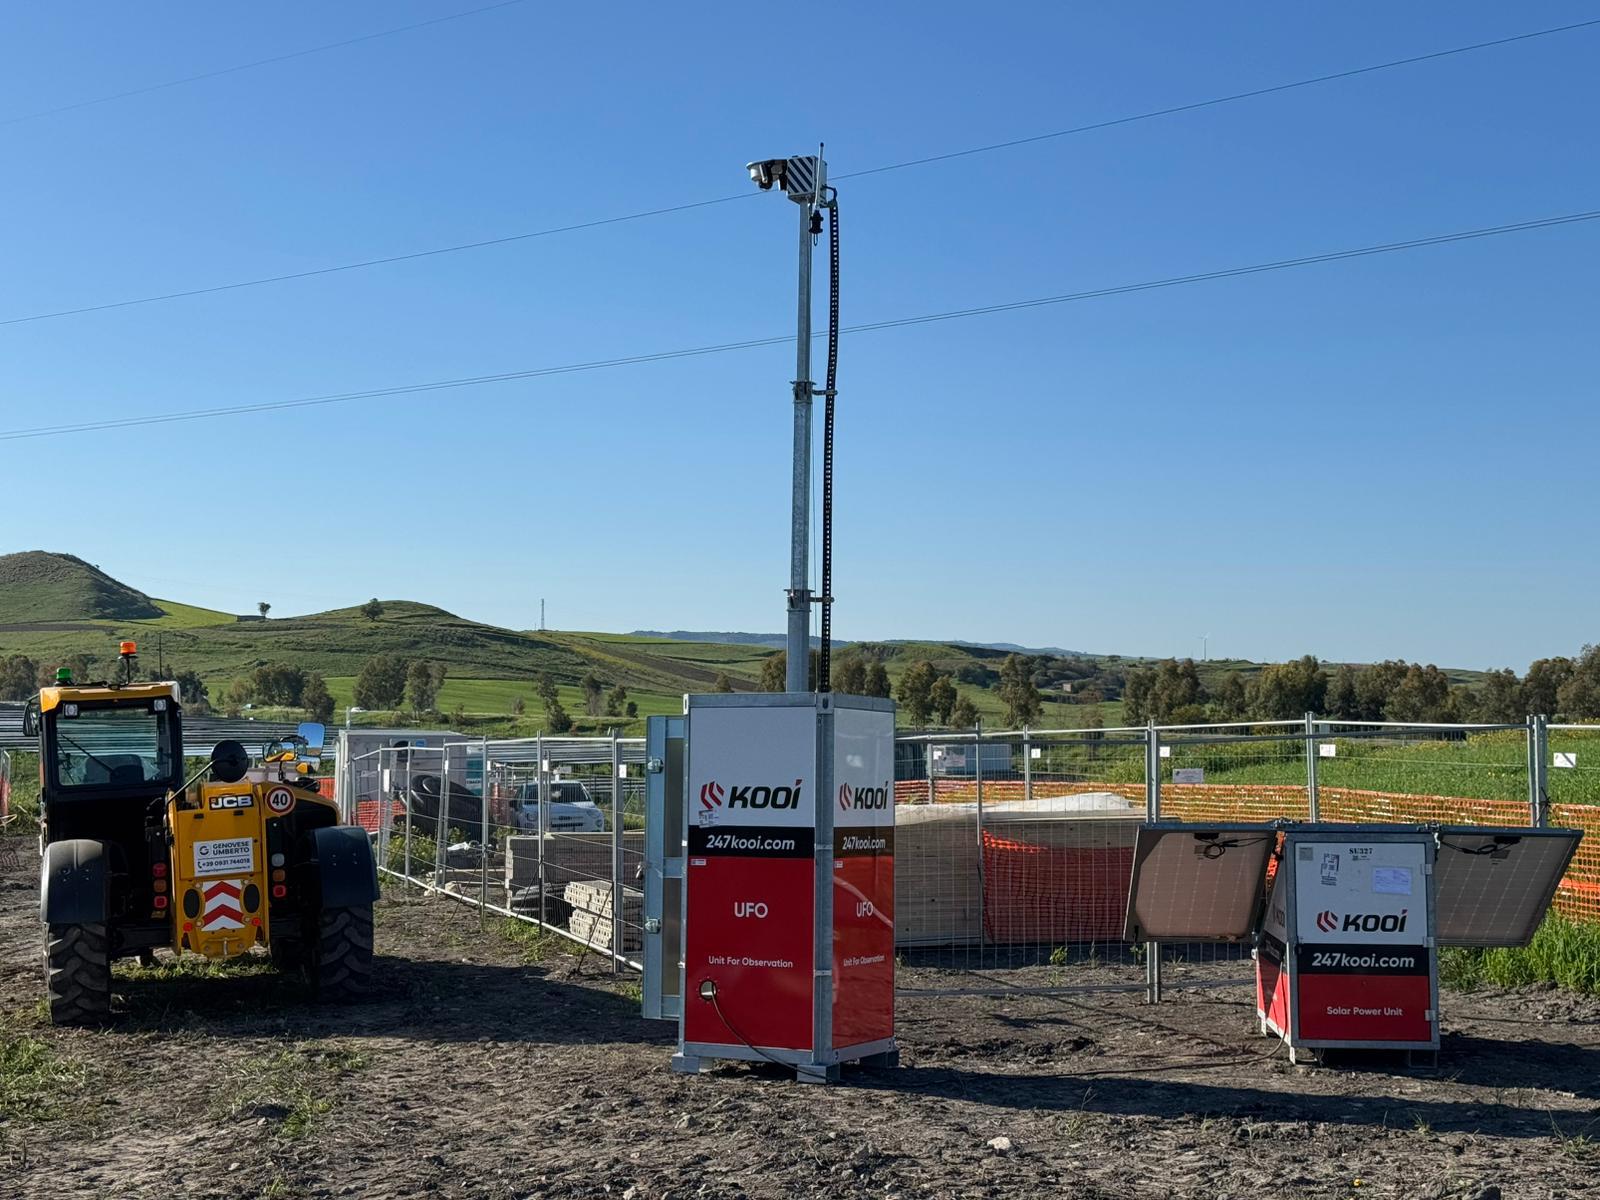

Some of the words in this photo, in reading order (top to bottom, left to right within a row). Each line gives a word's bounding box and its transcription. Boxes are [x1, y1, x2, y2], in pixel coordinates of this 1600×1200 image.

[211, 796, 252, 809] JCB
[272, 793, 288, 806] 40
[212, 841, 250, 850] GENOVESE
[705, 834, 795, 850] 247kooi.com
[842, 836, 886, 850] 247kooi.com
[212, 847, 250, 856] UMBERTO
[734, 901, 769, 918] UFO
[856, 902, 874, 917] UFO
[708, 955, 725, 965] Unit
[726, 956, 740, 965] For
[741, 957, 793, 968] Observation
[1311, 953, 1415, 968] 247kooi.com
[1327, 1006, 1351, 1015] Solar
[1353, 1006, 1381, 1015] Power
[1383, 1007, 1403, 1016] Unit
